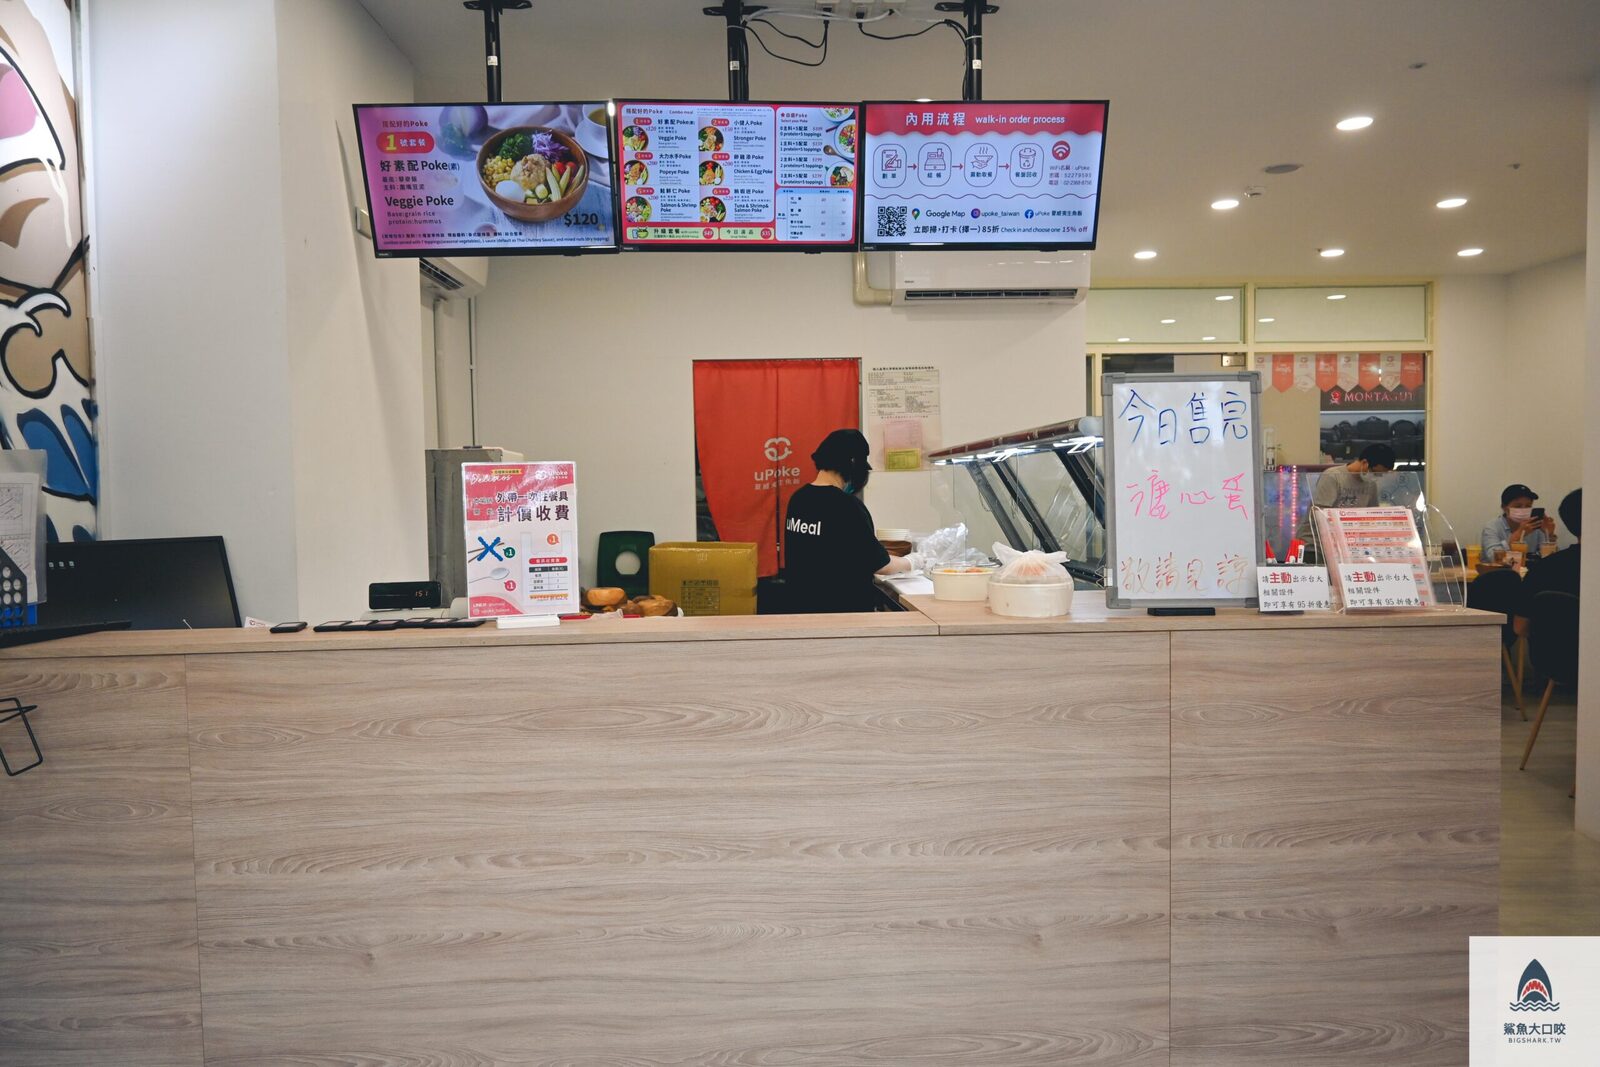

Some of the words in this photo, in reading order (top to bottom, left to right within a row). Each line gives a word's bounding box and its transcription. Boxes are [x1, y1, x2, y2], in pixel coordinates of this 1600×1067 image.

[905, 112, 966, 126] 內用流程
[975, 114, 1007, 124] walk-in
[1009, 115, 1031, 124] order
[1033, 115, 1065, 126] process
[659, 169, 677, 177] Popeye
[385, 196, 423, 209] Veggie
[426, 195, 454, 206] Poke
[423, 210, 436, 218] rice
[563, 212, 599, 227] $120
[925, 209, 951, 219] Google
[951, 209, 966, 219] Map
[981, 210, 1020, 219] upoke_taiwan
[1062, 225, 1076, 233] 15%
[1078, 225, 1089, 233] off
[754, 466, 801, 481] uPoke
[498, 504, 570, 522] 計價收費
